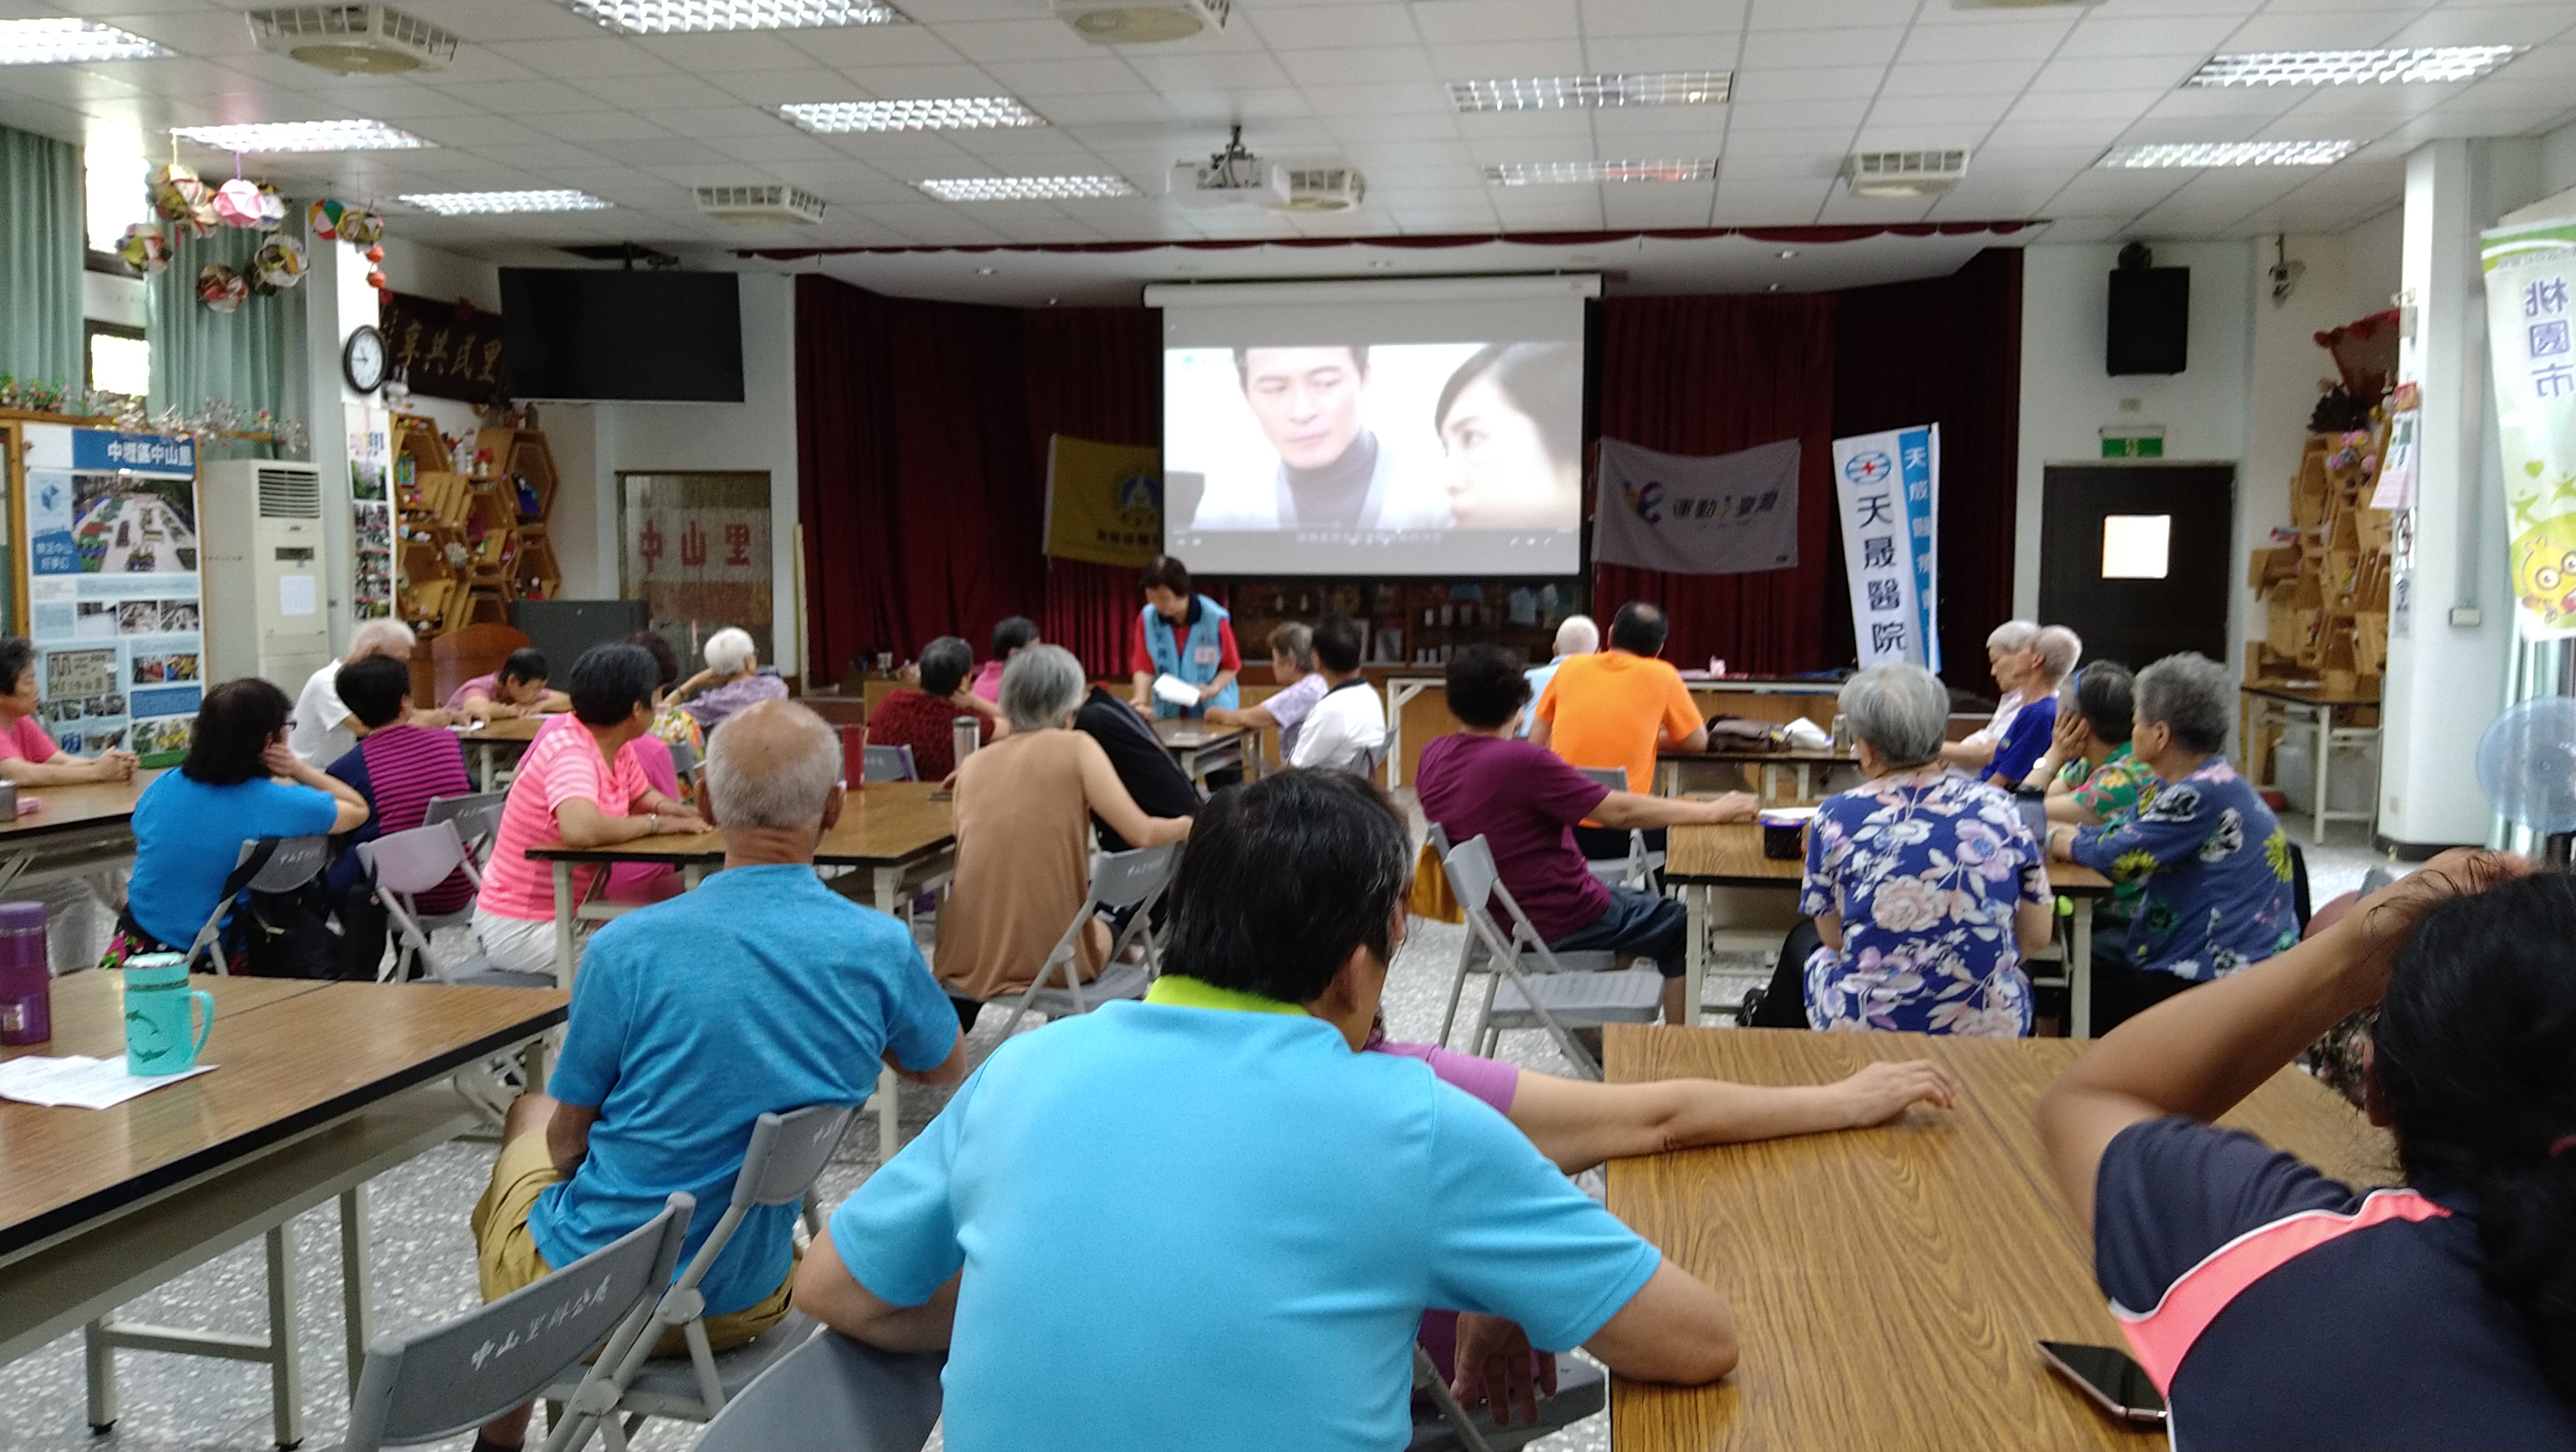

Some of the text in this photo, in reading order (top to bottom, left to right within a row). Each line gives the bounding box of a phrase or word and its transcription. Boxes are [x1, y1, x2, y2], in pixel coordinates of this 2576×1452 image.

[107, 439, 194, 467] 中壢區中山里
[638, 517, 751, 574] 中山里
[1857, 493, 1906, 654] 天晟醫院
